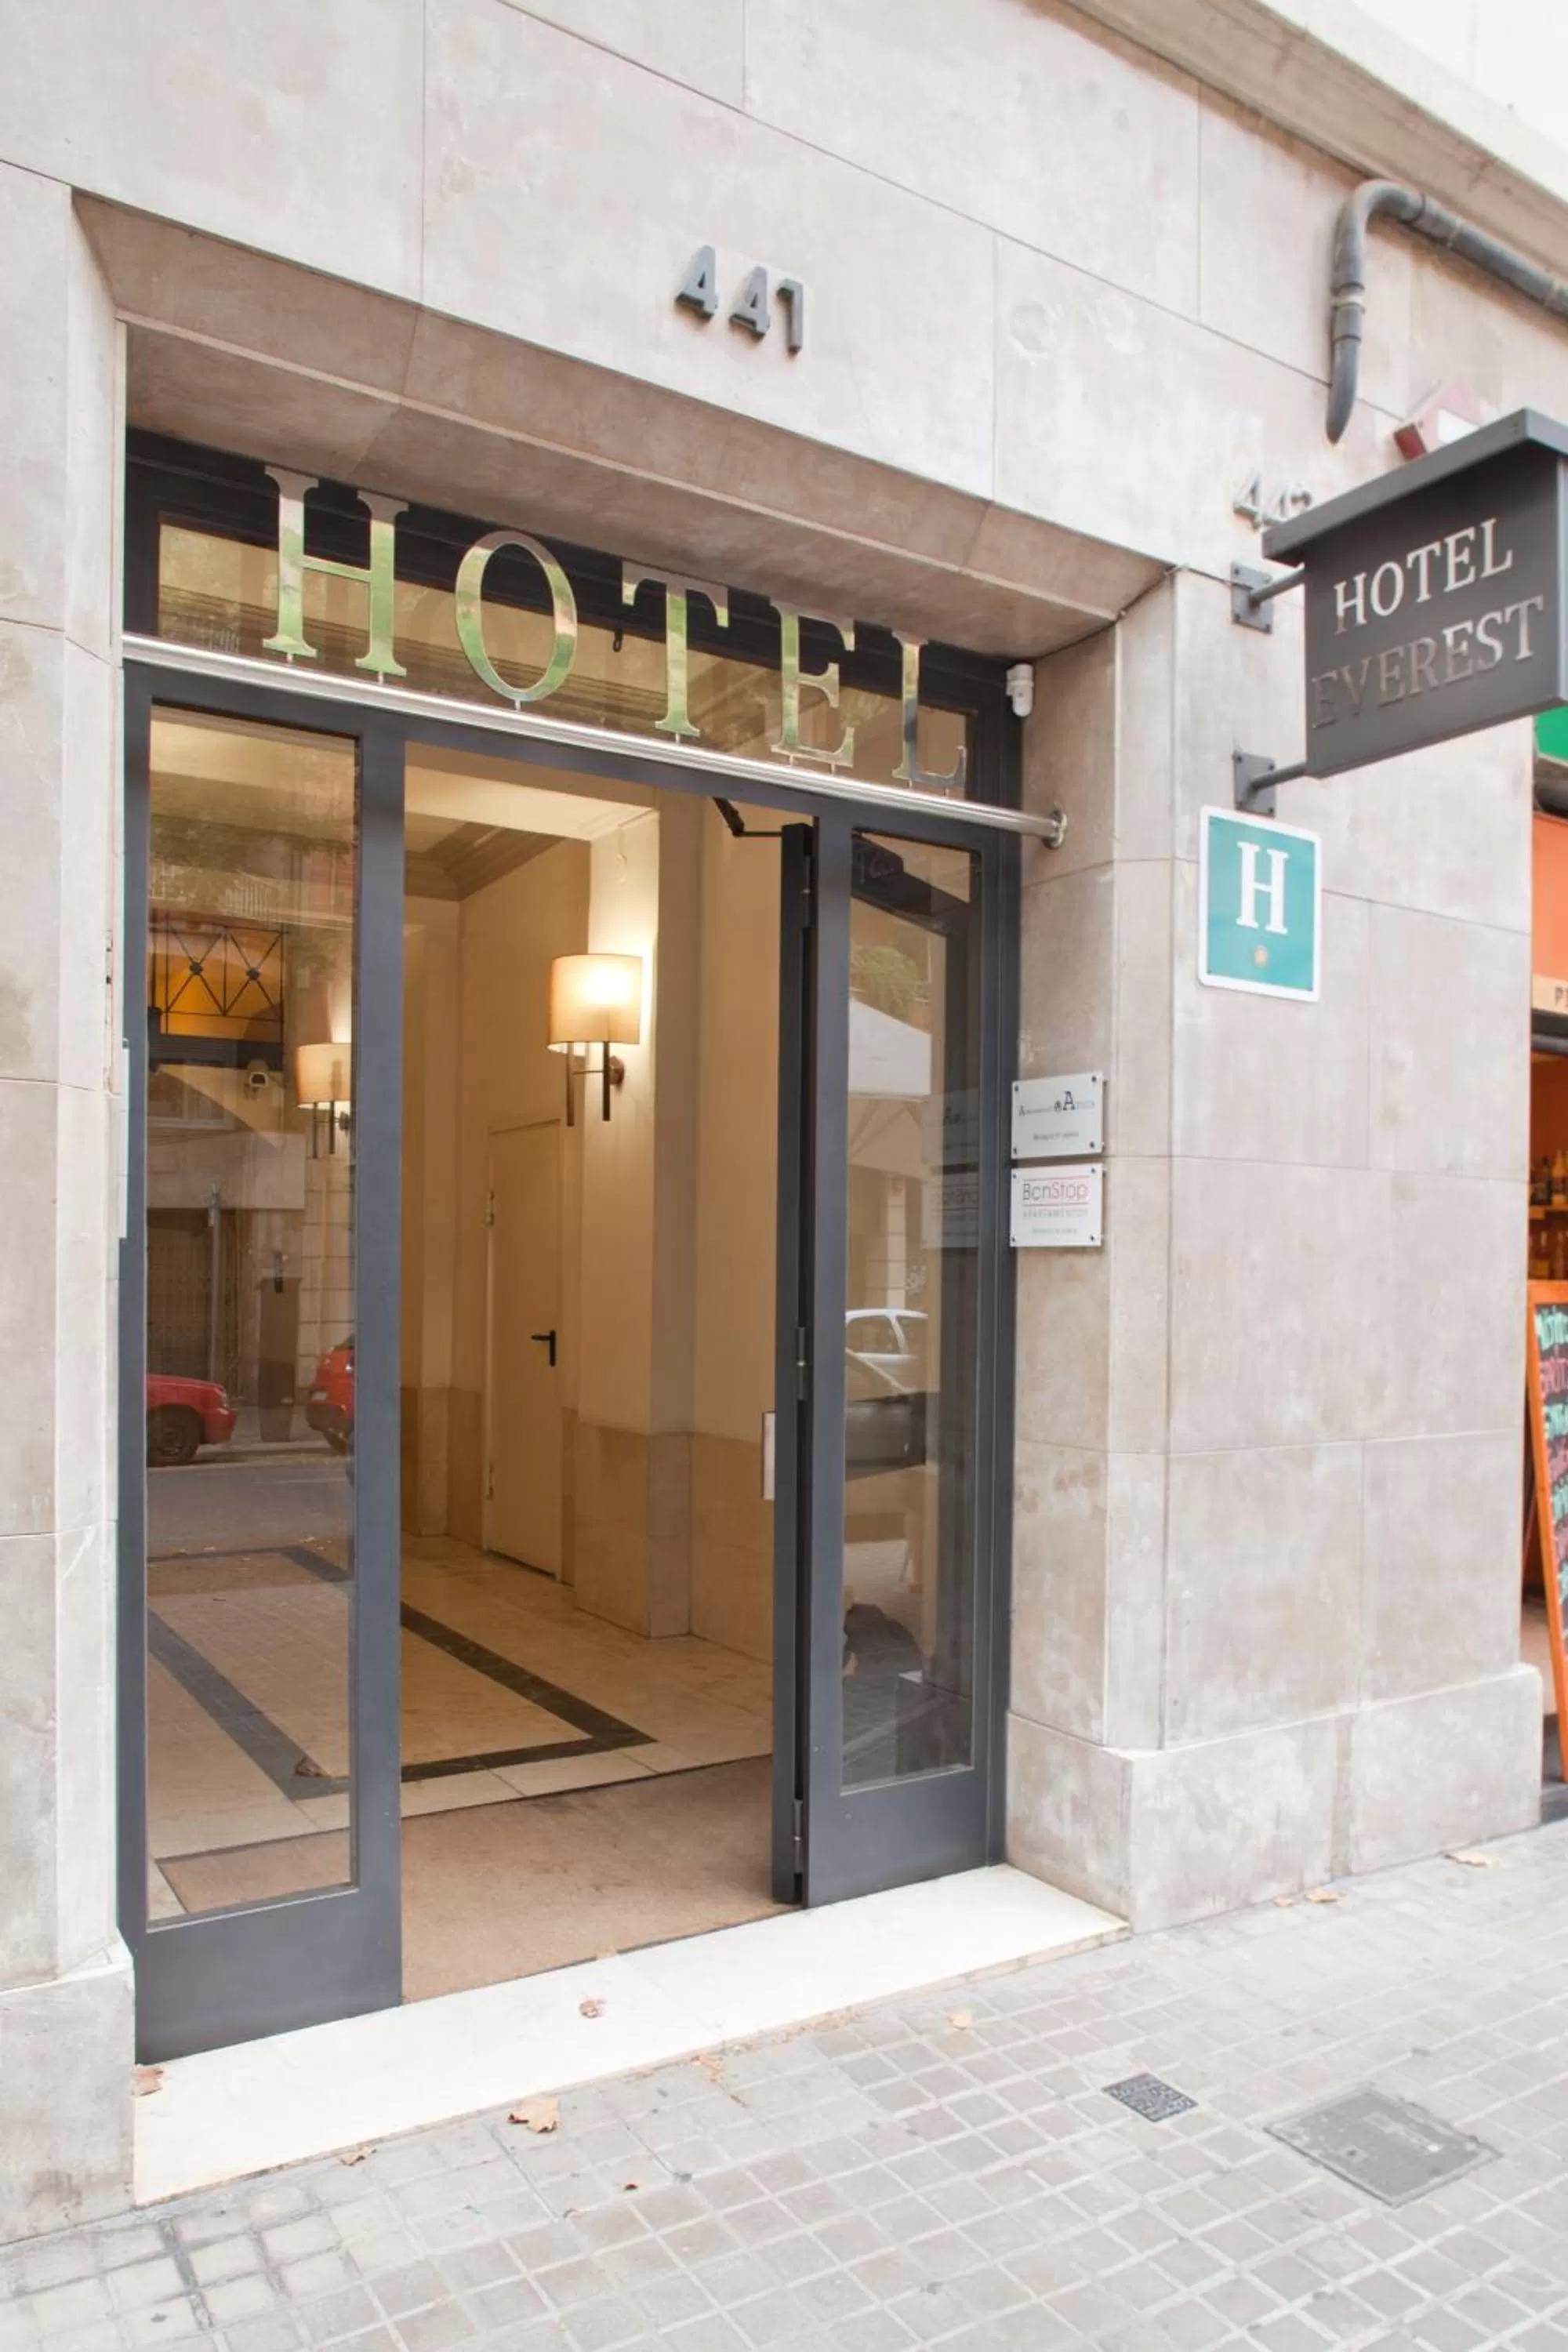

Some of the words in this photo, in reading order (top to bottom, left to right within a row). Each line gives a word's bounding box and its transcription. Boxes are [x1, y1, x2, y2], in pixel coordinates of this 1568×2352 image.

[674, 245, 804, 353] 441
[263, 466, 967, 786] HOTEL
[1334, 518, 1513, 634] HOTEL
[1312, 595, 1544, 728] EVEREST
[1236, 840, 1289, 935] H
[1022, 1181, 1089, 1202] BcnStop
